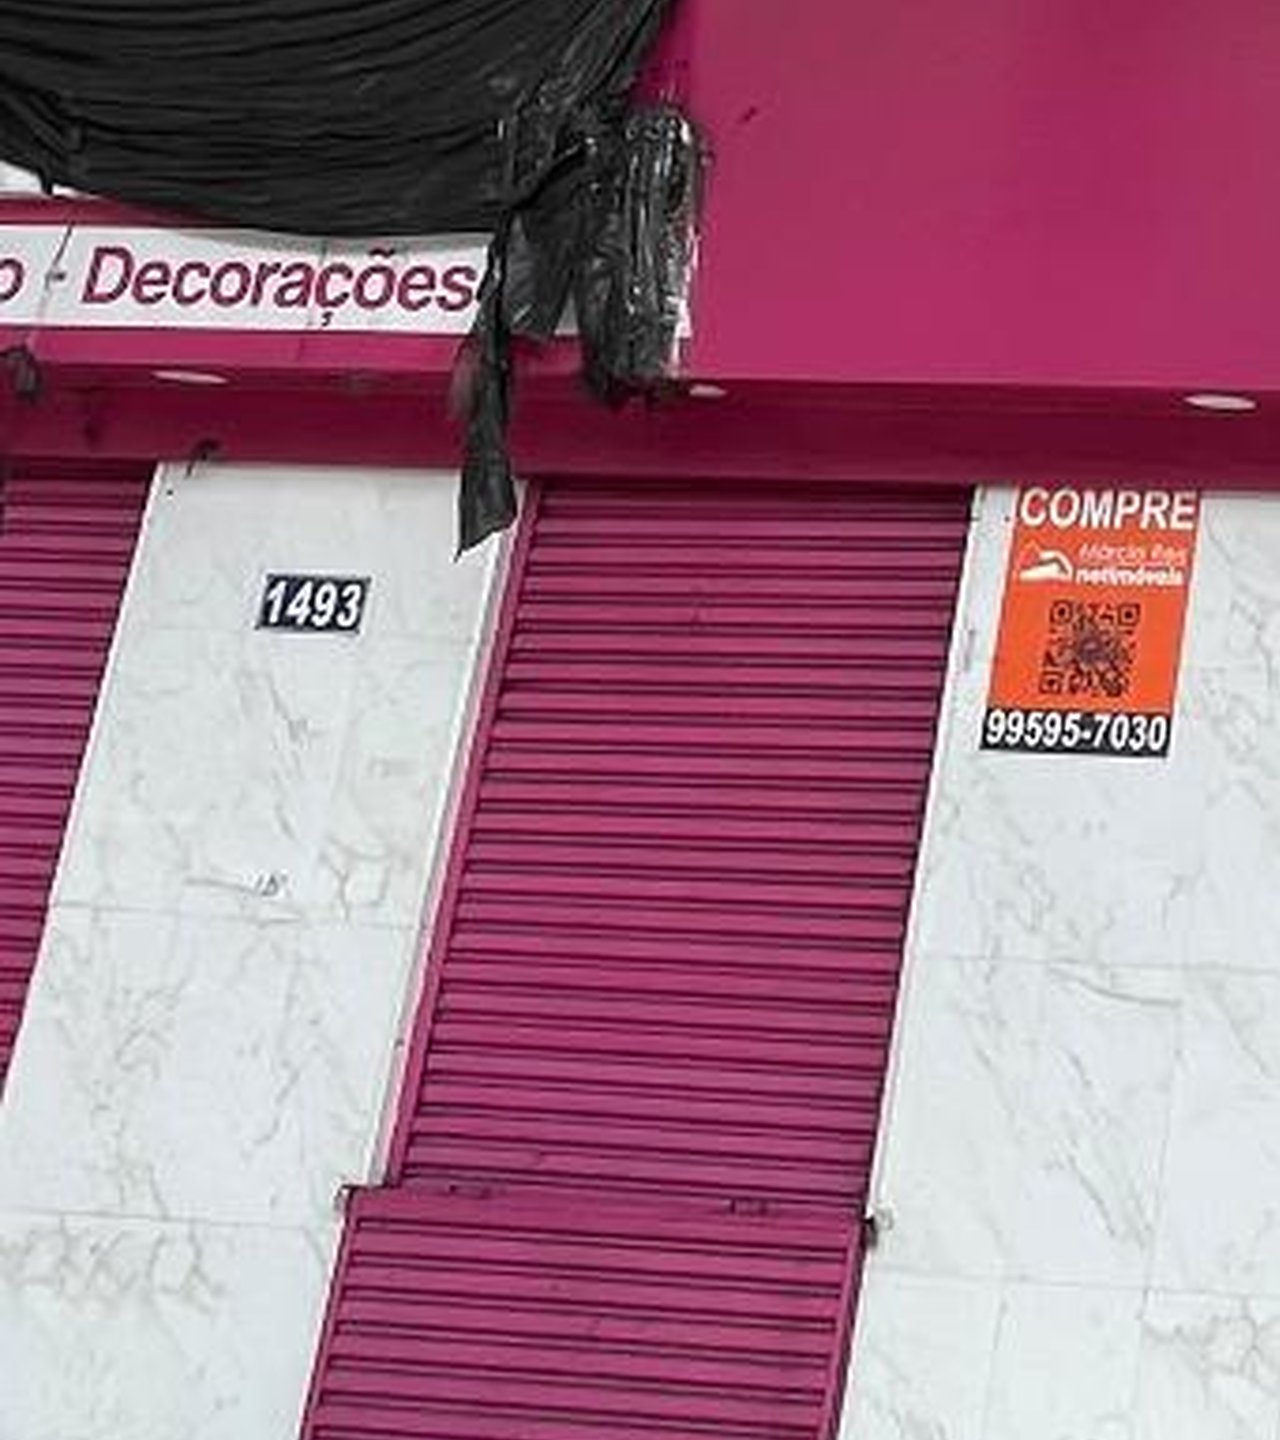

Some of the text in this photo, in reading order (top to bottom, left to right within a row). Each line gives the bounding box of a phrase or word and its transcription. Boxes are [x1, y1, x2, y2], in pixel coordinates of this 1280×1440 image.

[82, 246, 478, 327] Decorações
[1019, 486, 1198, 532] COMPRE
[266, 579, 362, 627] 1493
[985, 709, 1168, 751] 99595-7030
